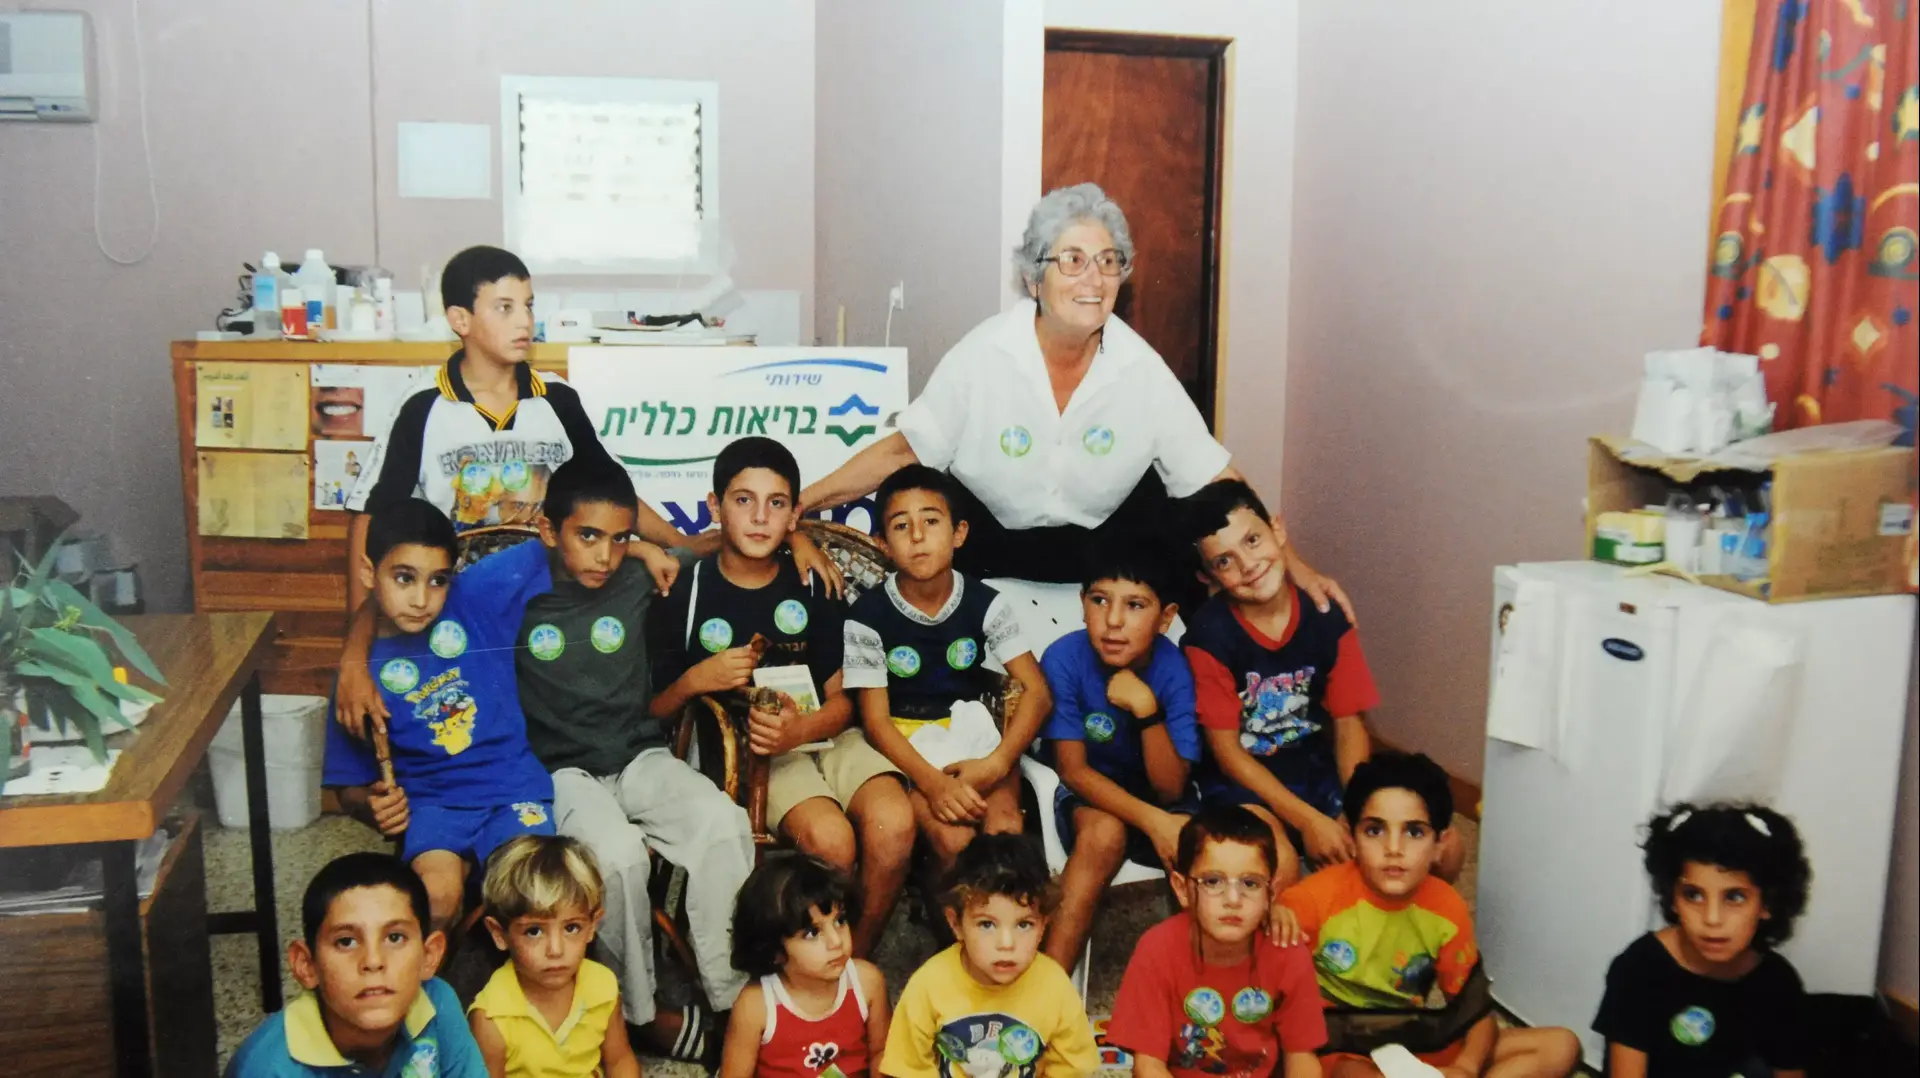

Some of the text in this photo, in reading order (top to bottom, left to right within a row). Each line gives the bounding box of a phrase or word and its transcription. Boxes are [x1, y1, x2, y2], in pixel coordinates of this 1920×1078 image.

[765, 373, 822, 387] שירותי
[600, 400, 818, 437] בריאות כללית
